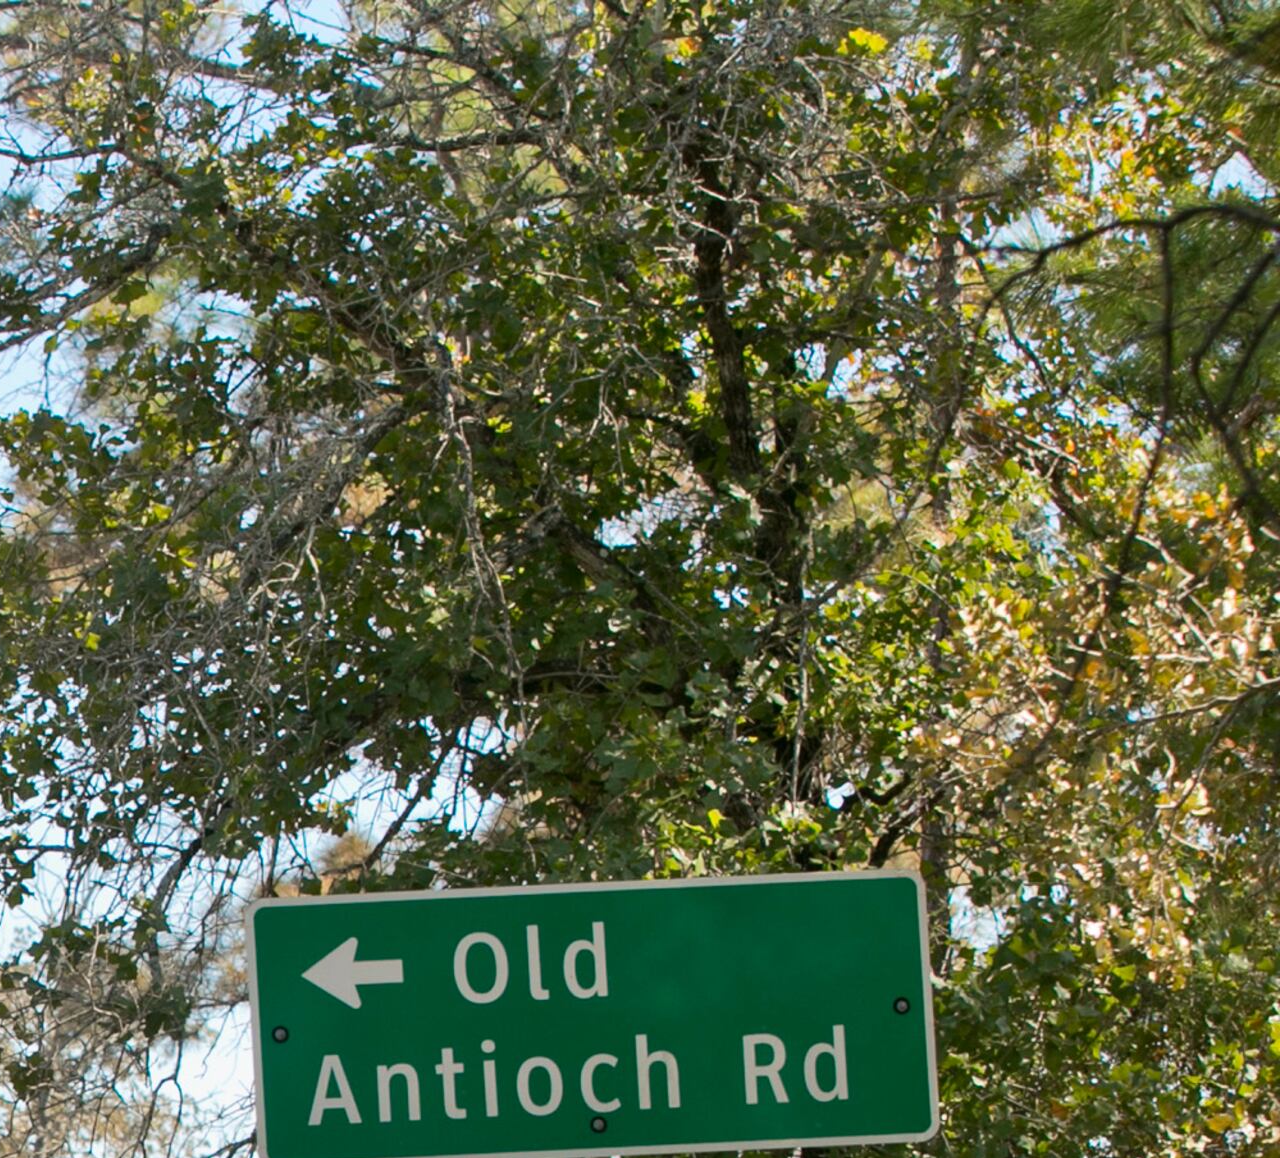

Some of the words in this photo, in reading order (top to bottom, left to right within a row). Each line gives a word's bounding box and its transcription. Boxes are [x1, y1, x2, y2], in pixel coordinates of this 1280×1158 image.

[453, 921, 609, 1004] Old
[308, 1034, 681, 1126] Antioch
[742, 1024, 849, 1105] Rd
